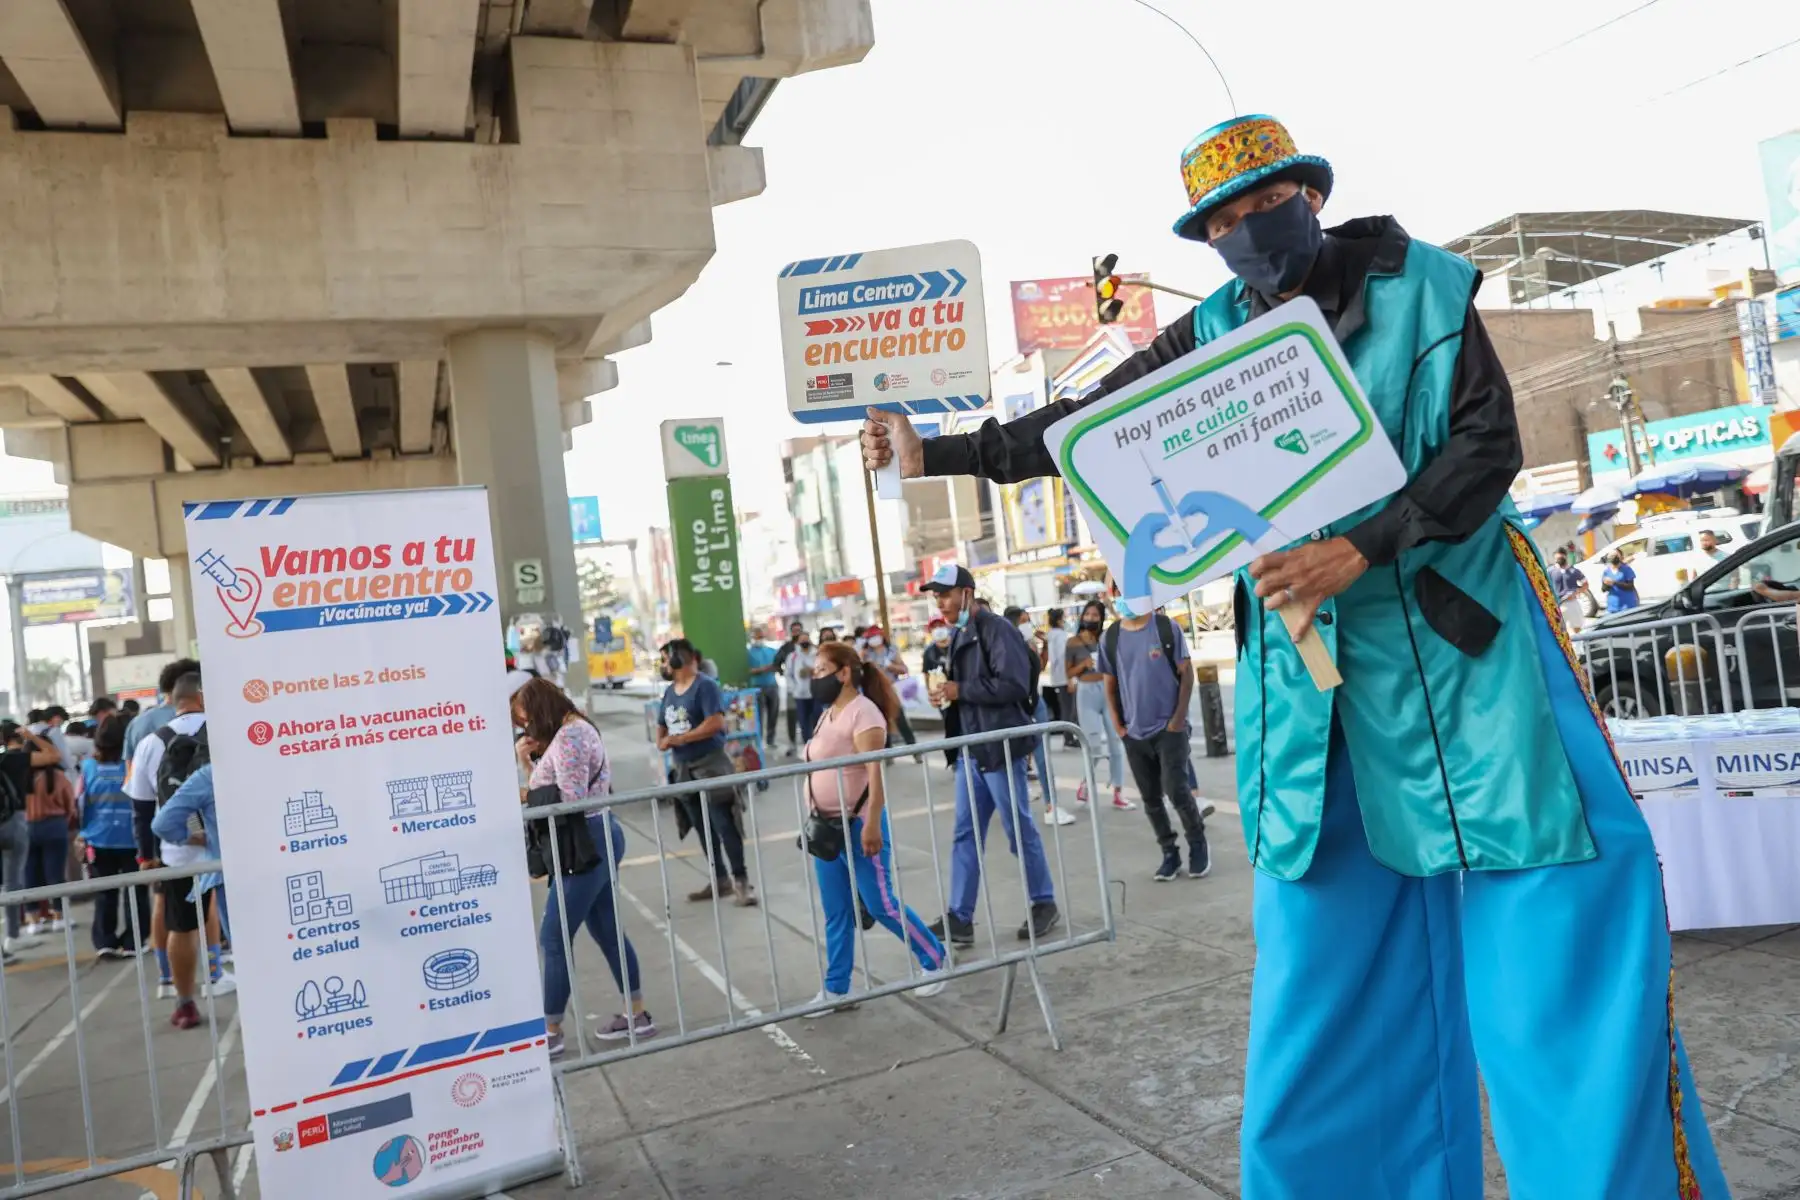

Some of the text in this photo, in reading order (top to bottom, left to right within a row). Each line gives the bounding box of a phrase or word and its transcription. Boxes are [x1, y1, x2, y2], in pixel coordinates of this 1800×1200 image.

[804, 281, 915, 309] Lima Centro
[868, 300, 965, 332] va a tu
[804, 327, 967, 366] encuentro
[1113, 345, 1299, 449] Hoy más que nunca
[1161, 428, 1194, 453] me
[1196, 399, 1249, 436] cuido
[1252, 388, 1267, 408] a
[1299, 366, 1311, 390] y
[1206, 388, 1324, 460] a mi familia
[1663, 416, 1760, 451] OPTICAS
[705, 443, 718, 465] 1
[710, 488, 735, 590] de Lima
[260, 535, 476, 578] Vamos a tu
[691, 519, 714, 593] Metro
[272, 566, 474, 608] encuentro
[519, 564, 539, 584] S
[319, 599, 430, 626] ¡Vacúnate ya!
[272, 664, 426, 696] Ponte las 2 dosis
[277, 701, 467, 738] Ahora la vacunación
[279, 717, 487, 757] estará más cerca de ti:
[401, 812, 477, 834] Mercados
[290, 832, 349, 854] Barrios
[419, 897, 479, 918] Centros
[296, 918, 361, 941] Centros
[400, 911, 493, 938] comerciales
[292, 936, 360, 963] de salud
[428, 988, 492, 1012] Estadios
[307, 1014, 374, 1040] Parques
[302, 1124, 325, 1138] PERÚ
[428, 1127, 459, 1142] Pongo
[429, 1132, 480, 1152] el hombro
[430, 1151, 448, 1165] por
[450, 1145, 459, 1156] el
